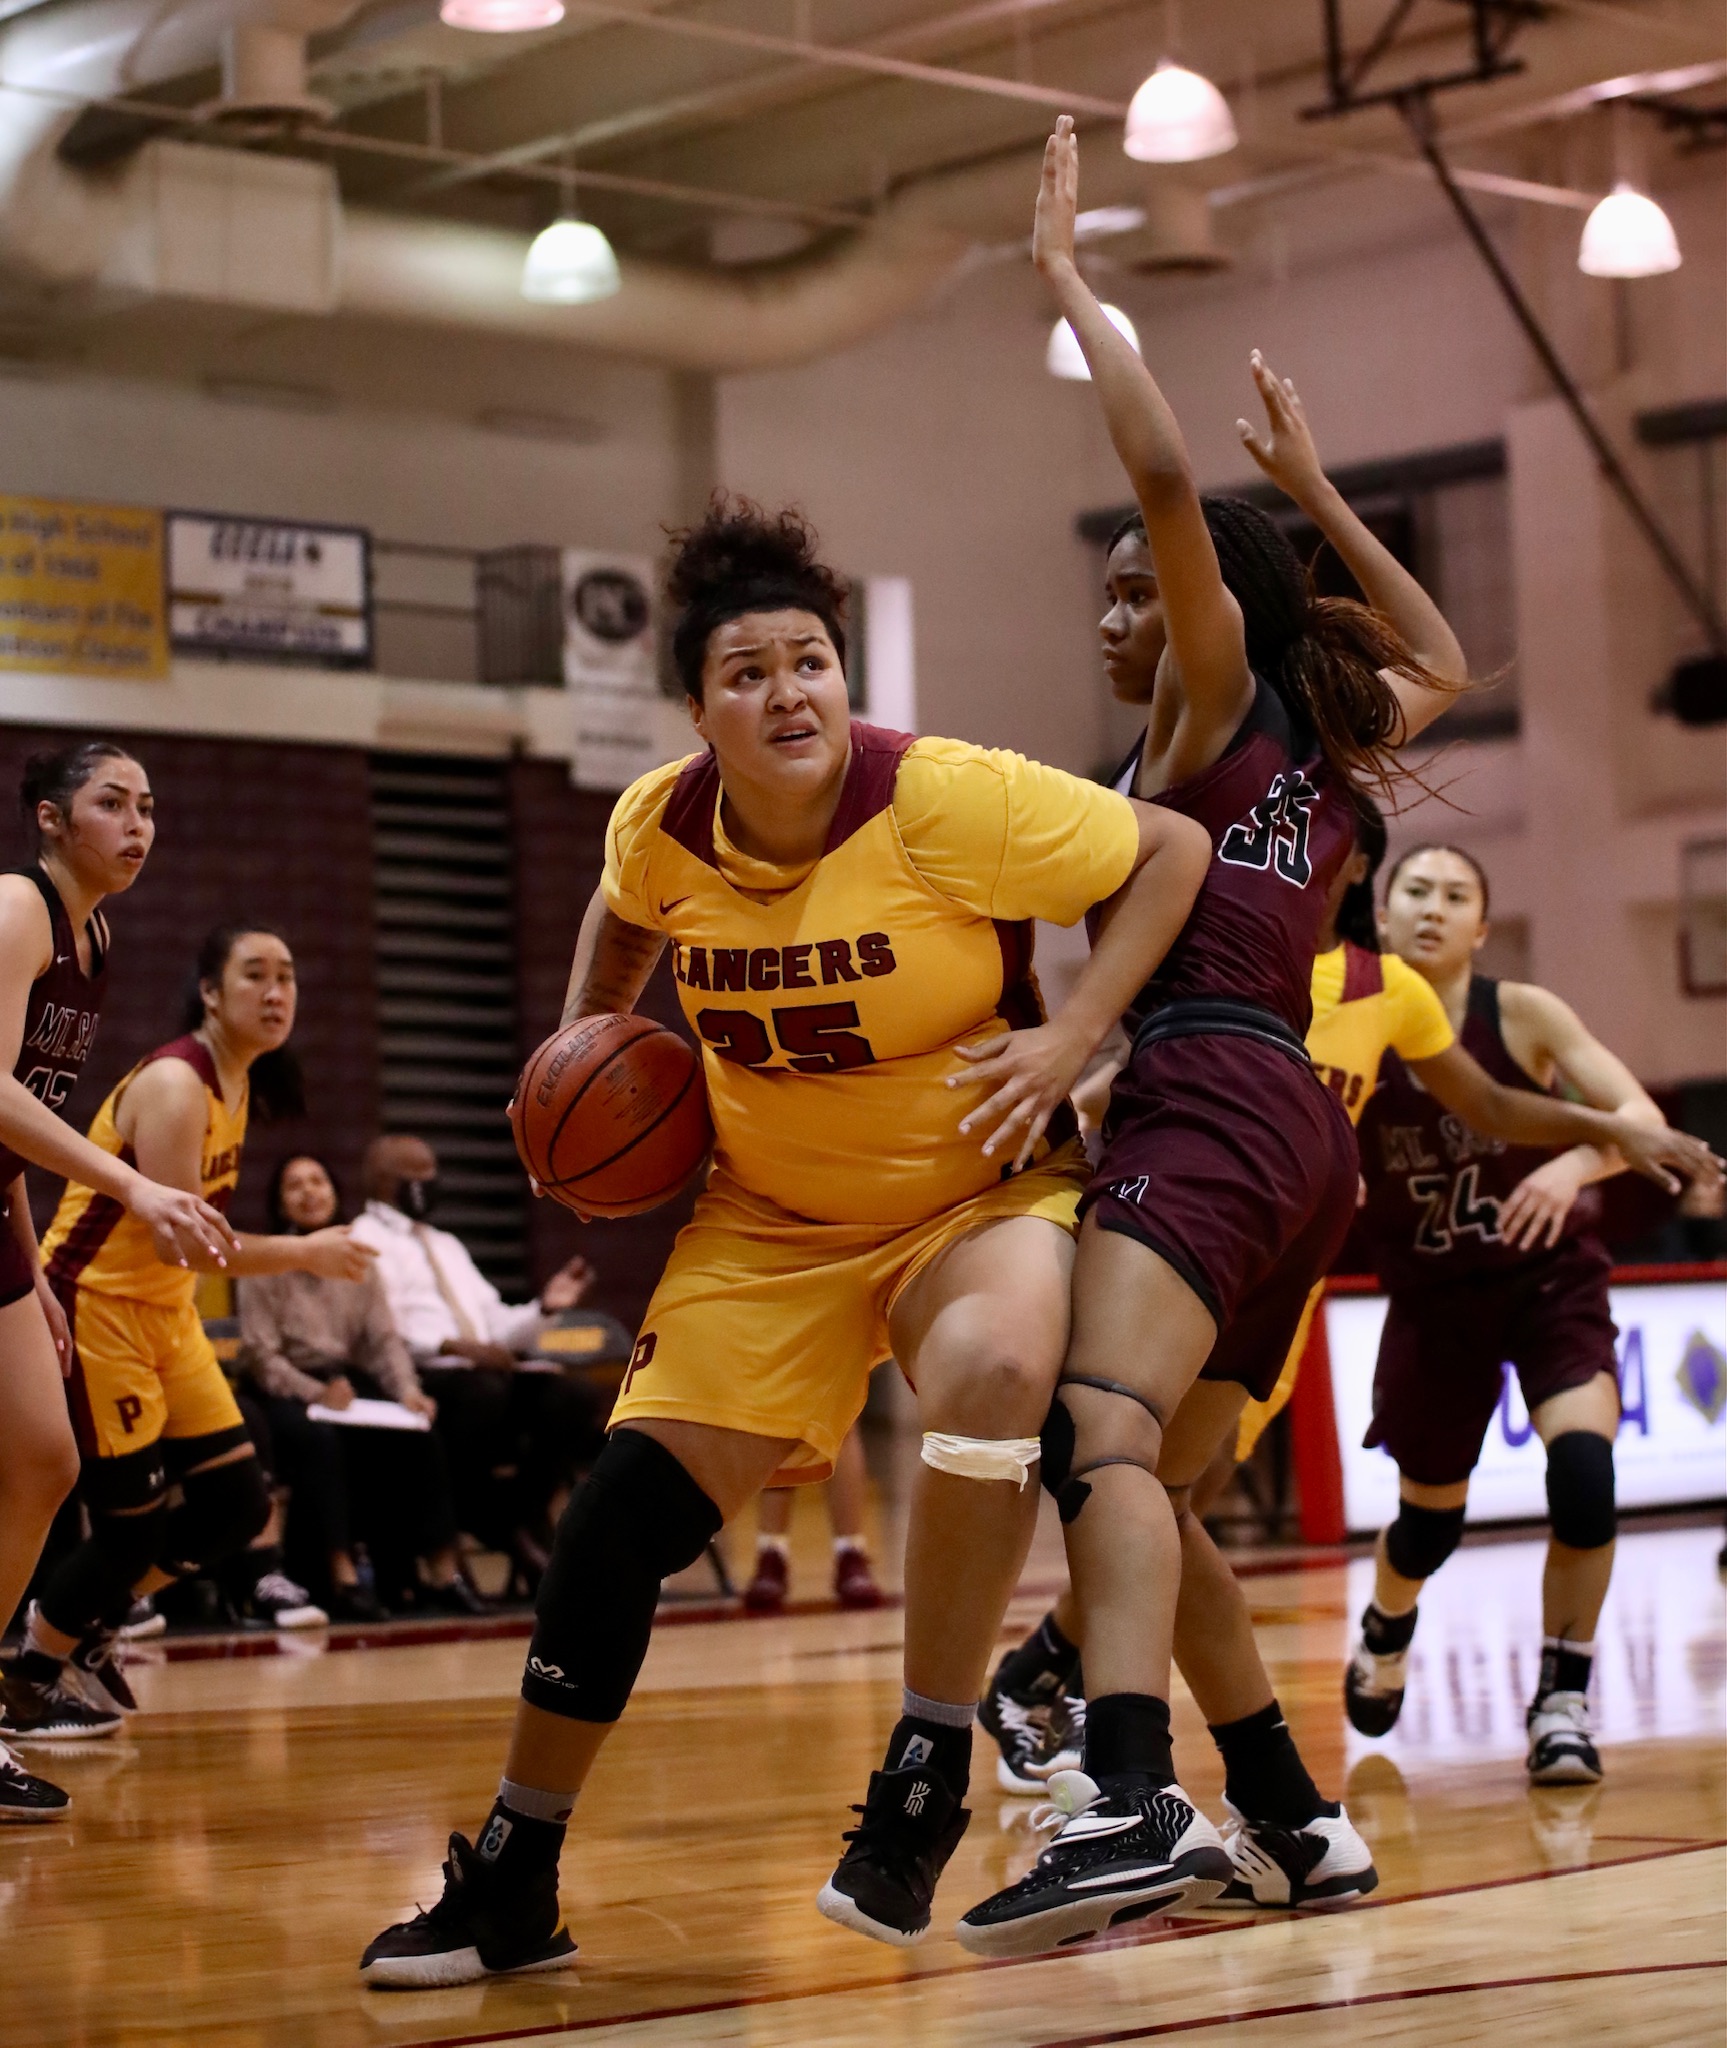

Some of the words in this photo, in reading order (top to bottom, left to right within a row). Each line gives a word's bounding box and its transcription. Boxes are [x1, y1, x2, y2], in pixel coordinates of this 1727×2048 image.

[671, 931, 897, 992] LANCERS
[696, 1001, 876, 1074] 25
[623, 1331, 658, 1396] P
[113, 1394, 142, 1434] P
